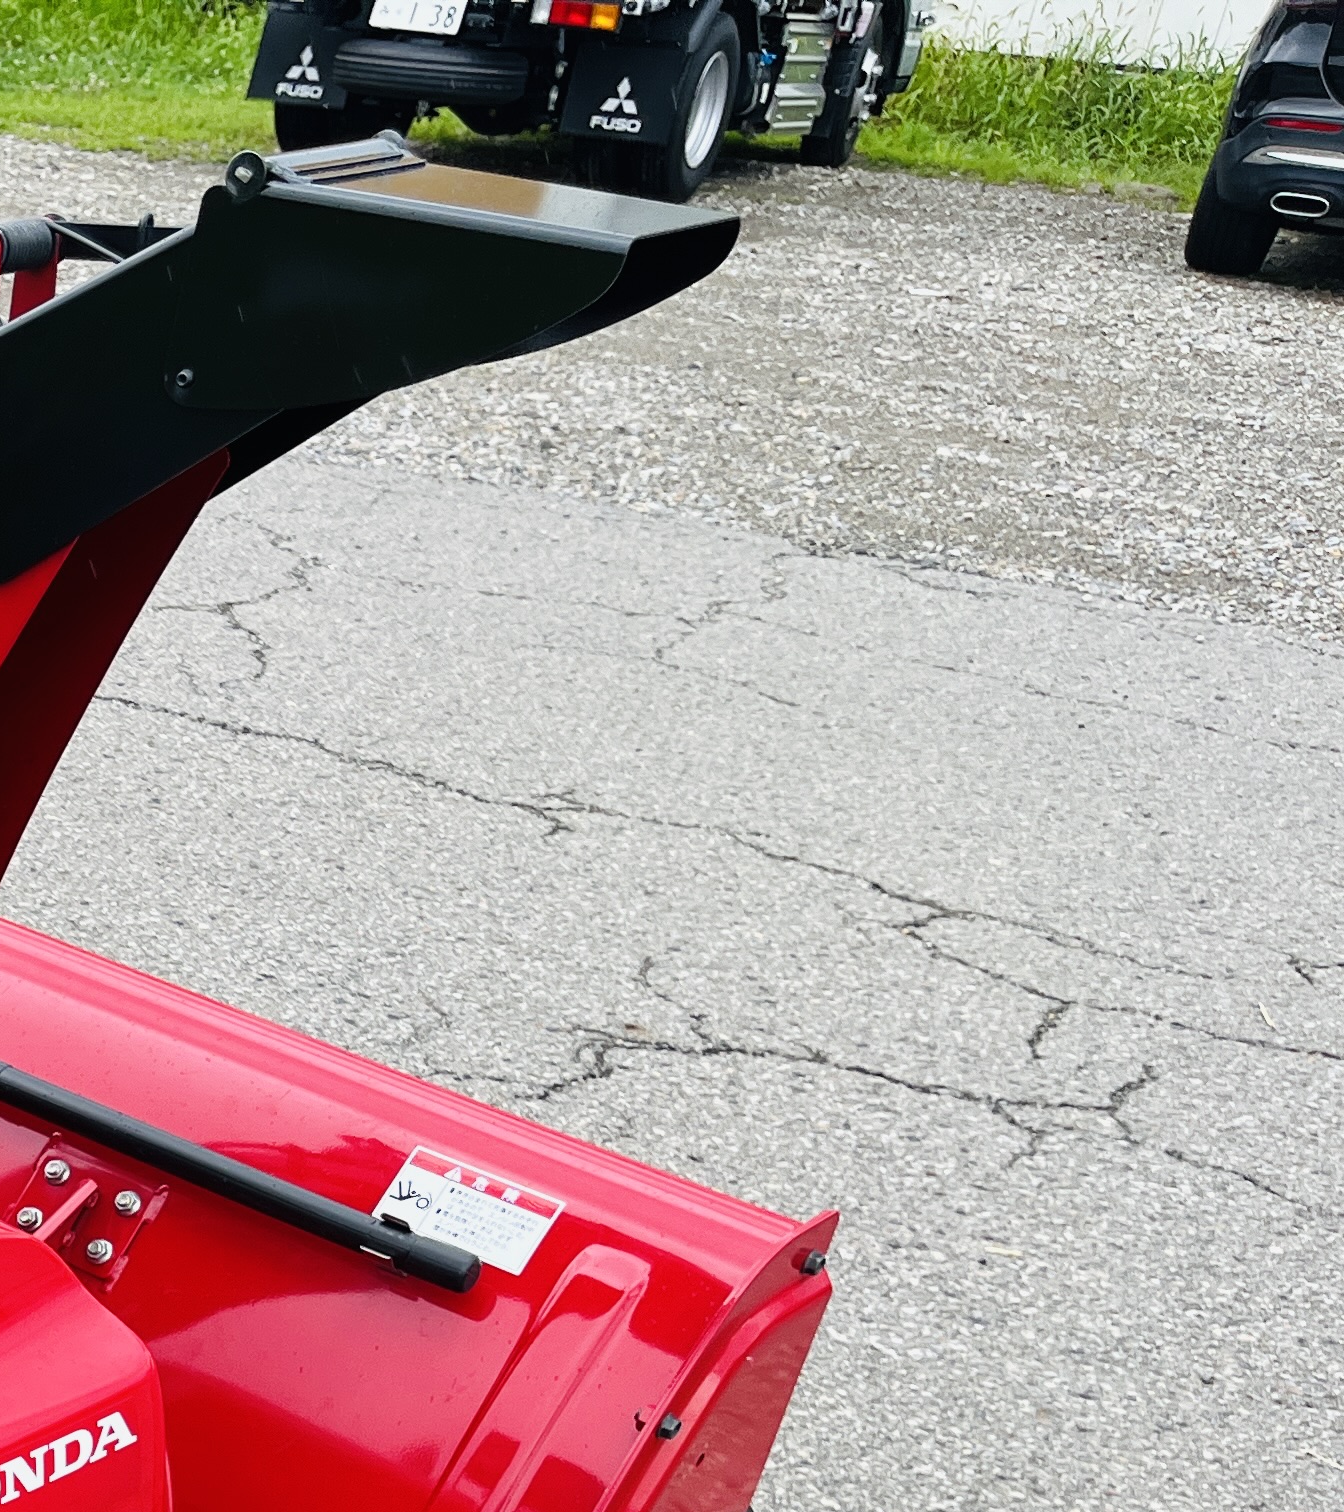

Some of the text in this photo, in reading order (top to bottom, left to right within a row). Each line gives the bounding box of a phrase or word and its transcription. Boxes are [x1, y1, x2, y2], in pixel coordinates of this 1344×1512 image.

[428, 4, 457, 28] 38
[275, 82, 324, 100] FUSO
[589, 115, 642, 133] FUSO
